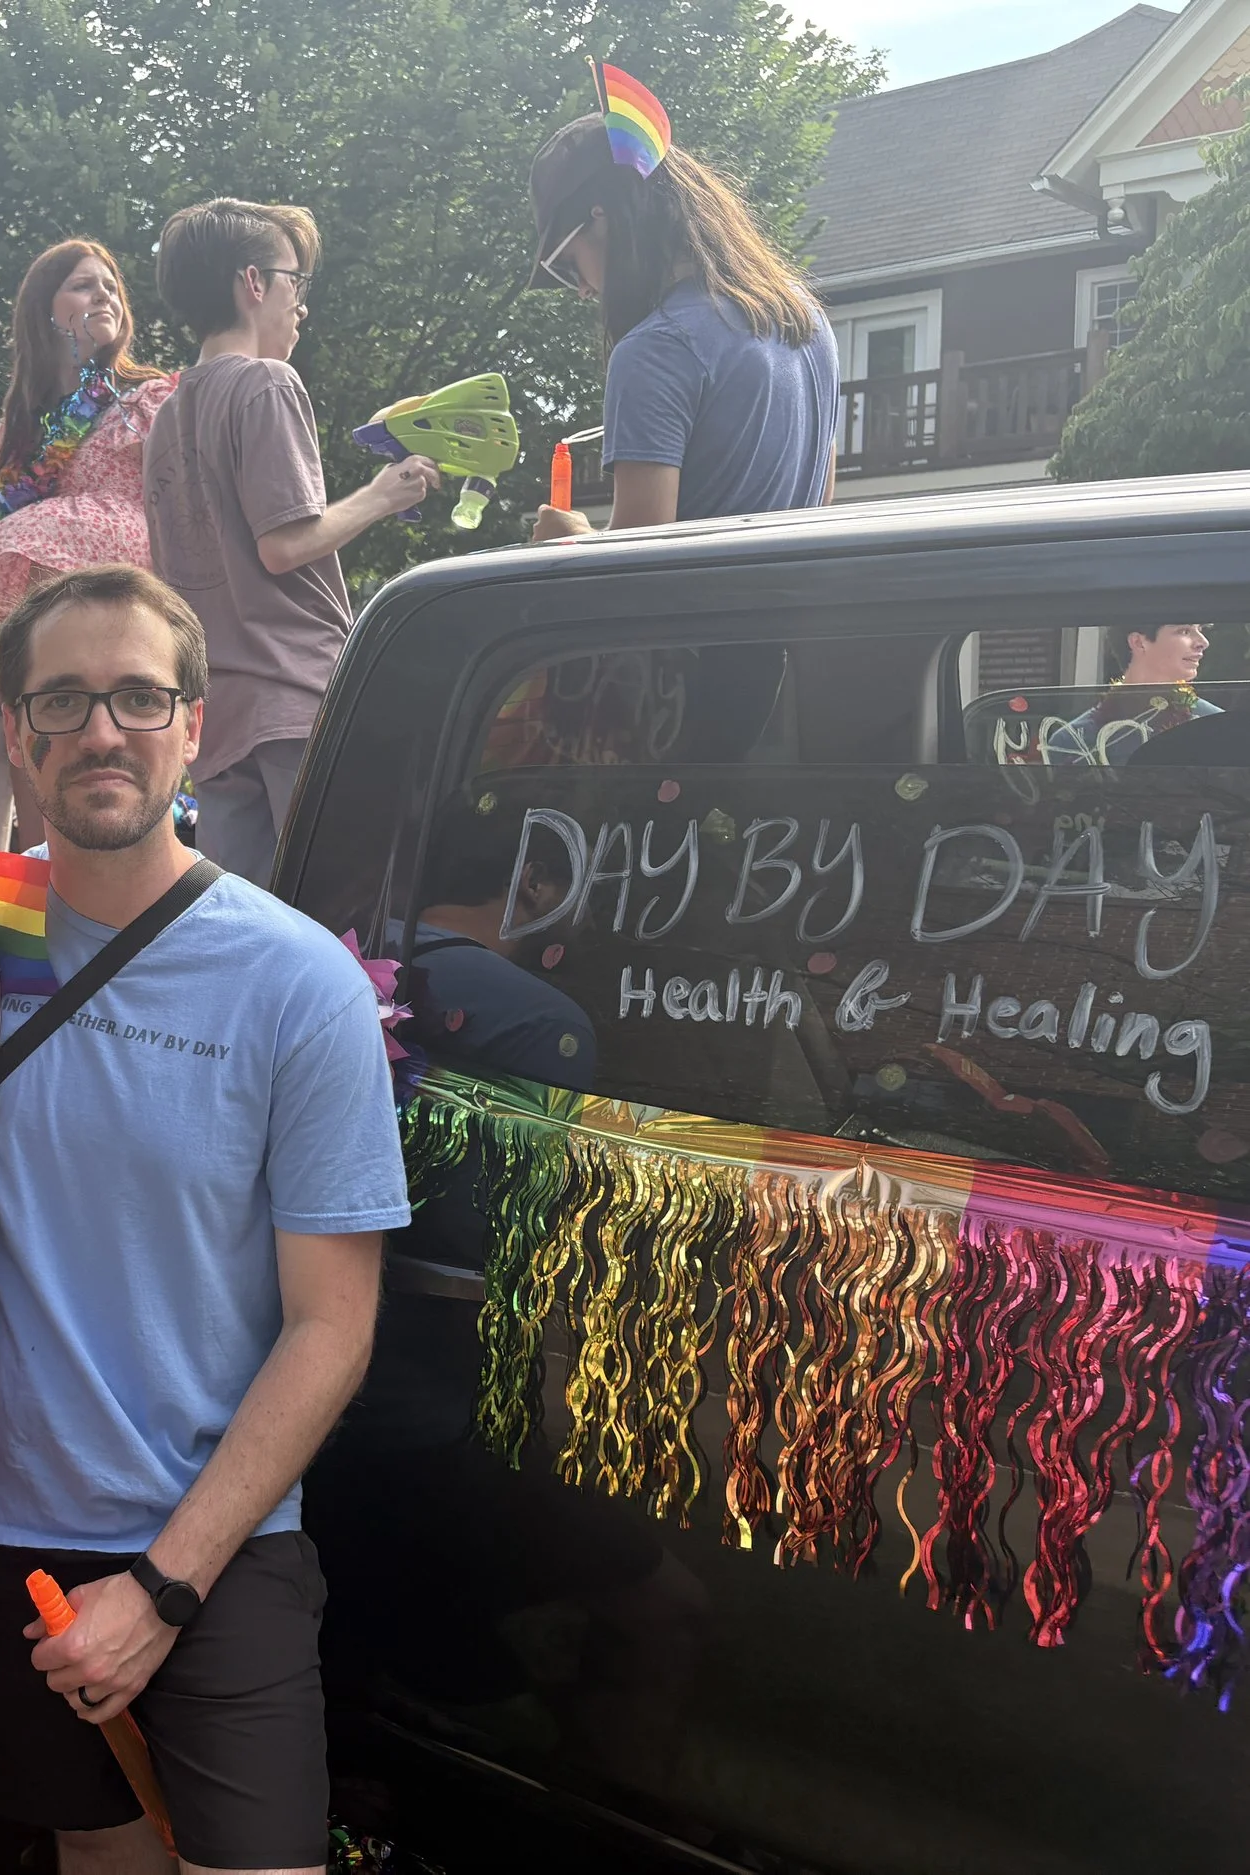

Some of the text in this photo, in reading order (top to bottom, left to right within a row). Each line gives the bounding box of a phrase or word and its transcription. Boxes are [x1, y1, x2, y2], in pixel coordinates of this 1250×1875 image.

[499, 807, 1220, 980] DAY BY DAY
[122, 1024, 162, 1045] DAY
[163, 1034, 190, 1052] BY
[192, 1041, 231, 1060] DAY
[619, 964, 803, 1031] Health
[936, 972, 1215, 1115] Healing
